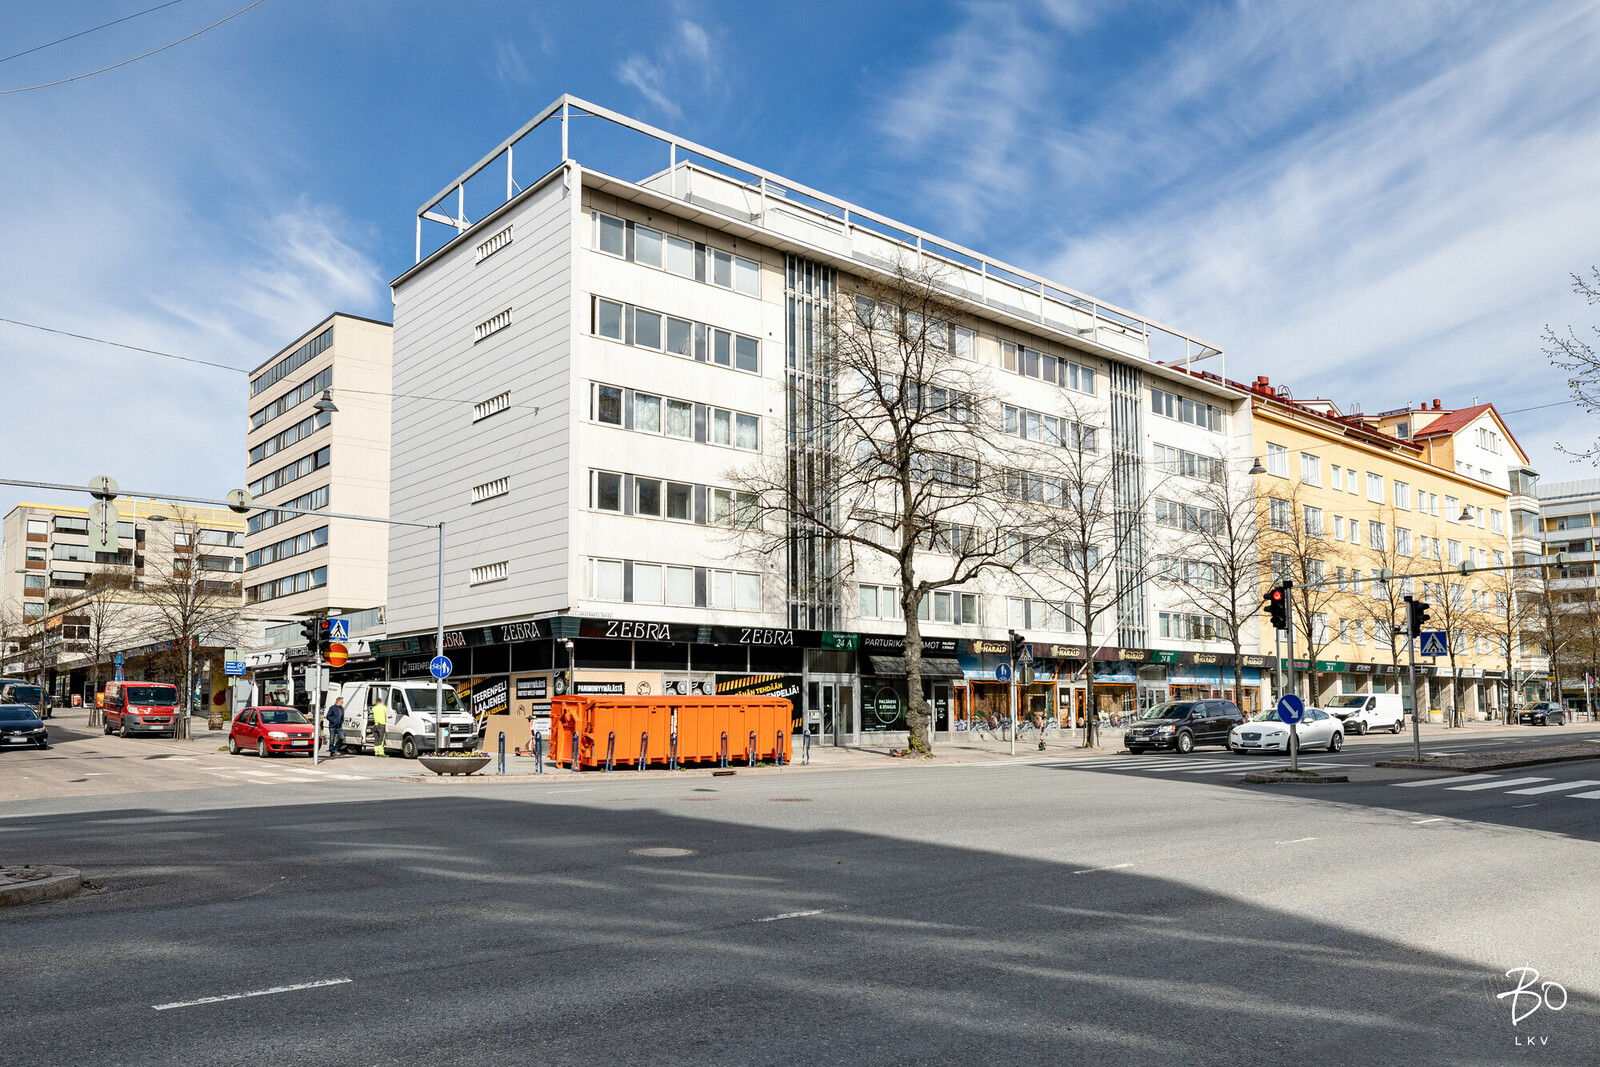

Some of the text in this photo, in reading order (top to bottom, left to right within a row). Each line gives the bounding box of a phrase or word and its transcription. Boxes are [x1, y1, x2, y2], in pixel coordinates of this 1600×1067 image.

[501, 621, 541, 642] ZEBRA
[605, 620, 671, 641] ZEBRA
[739, 628, 794, 646] ZEBRA
[835, 638, 845, 648] 24
[983, 645, 1008, 653] HARALD
[1058, 649, 1080, 657] HARALD
[408, 661, 430, 671] TEERENPEL
[473, 680, 508, 704] TEERENPELI
[755, 682, 783, 694] TEHDÄÄN
